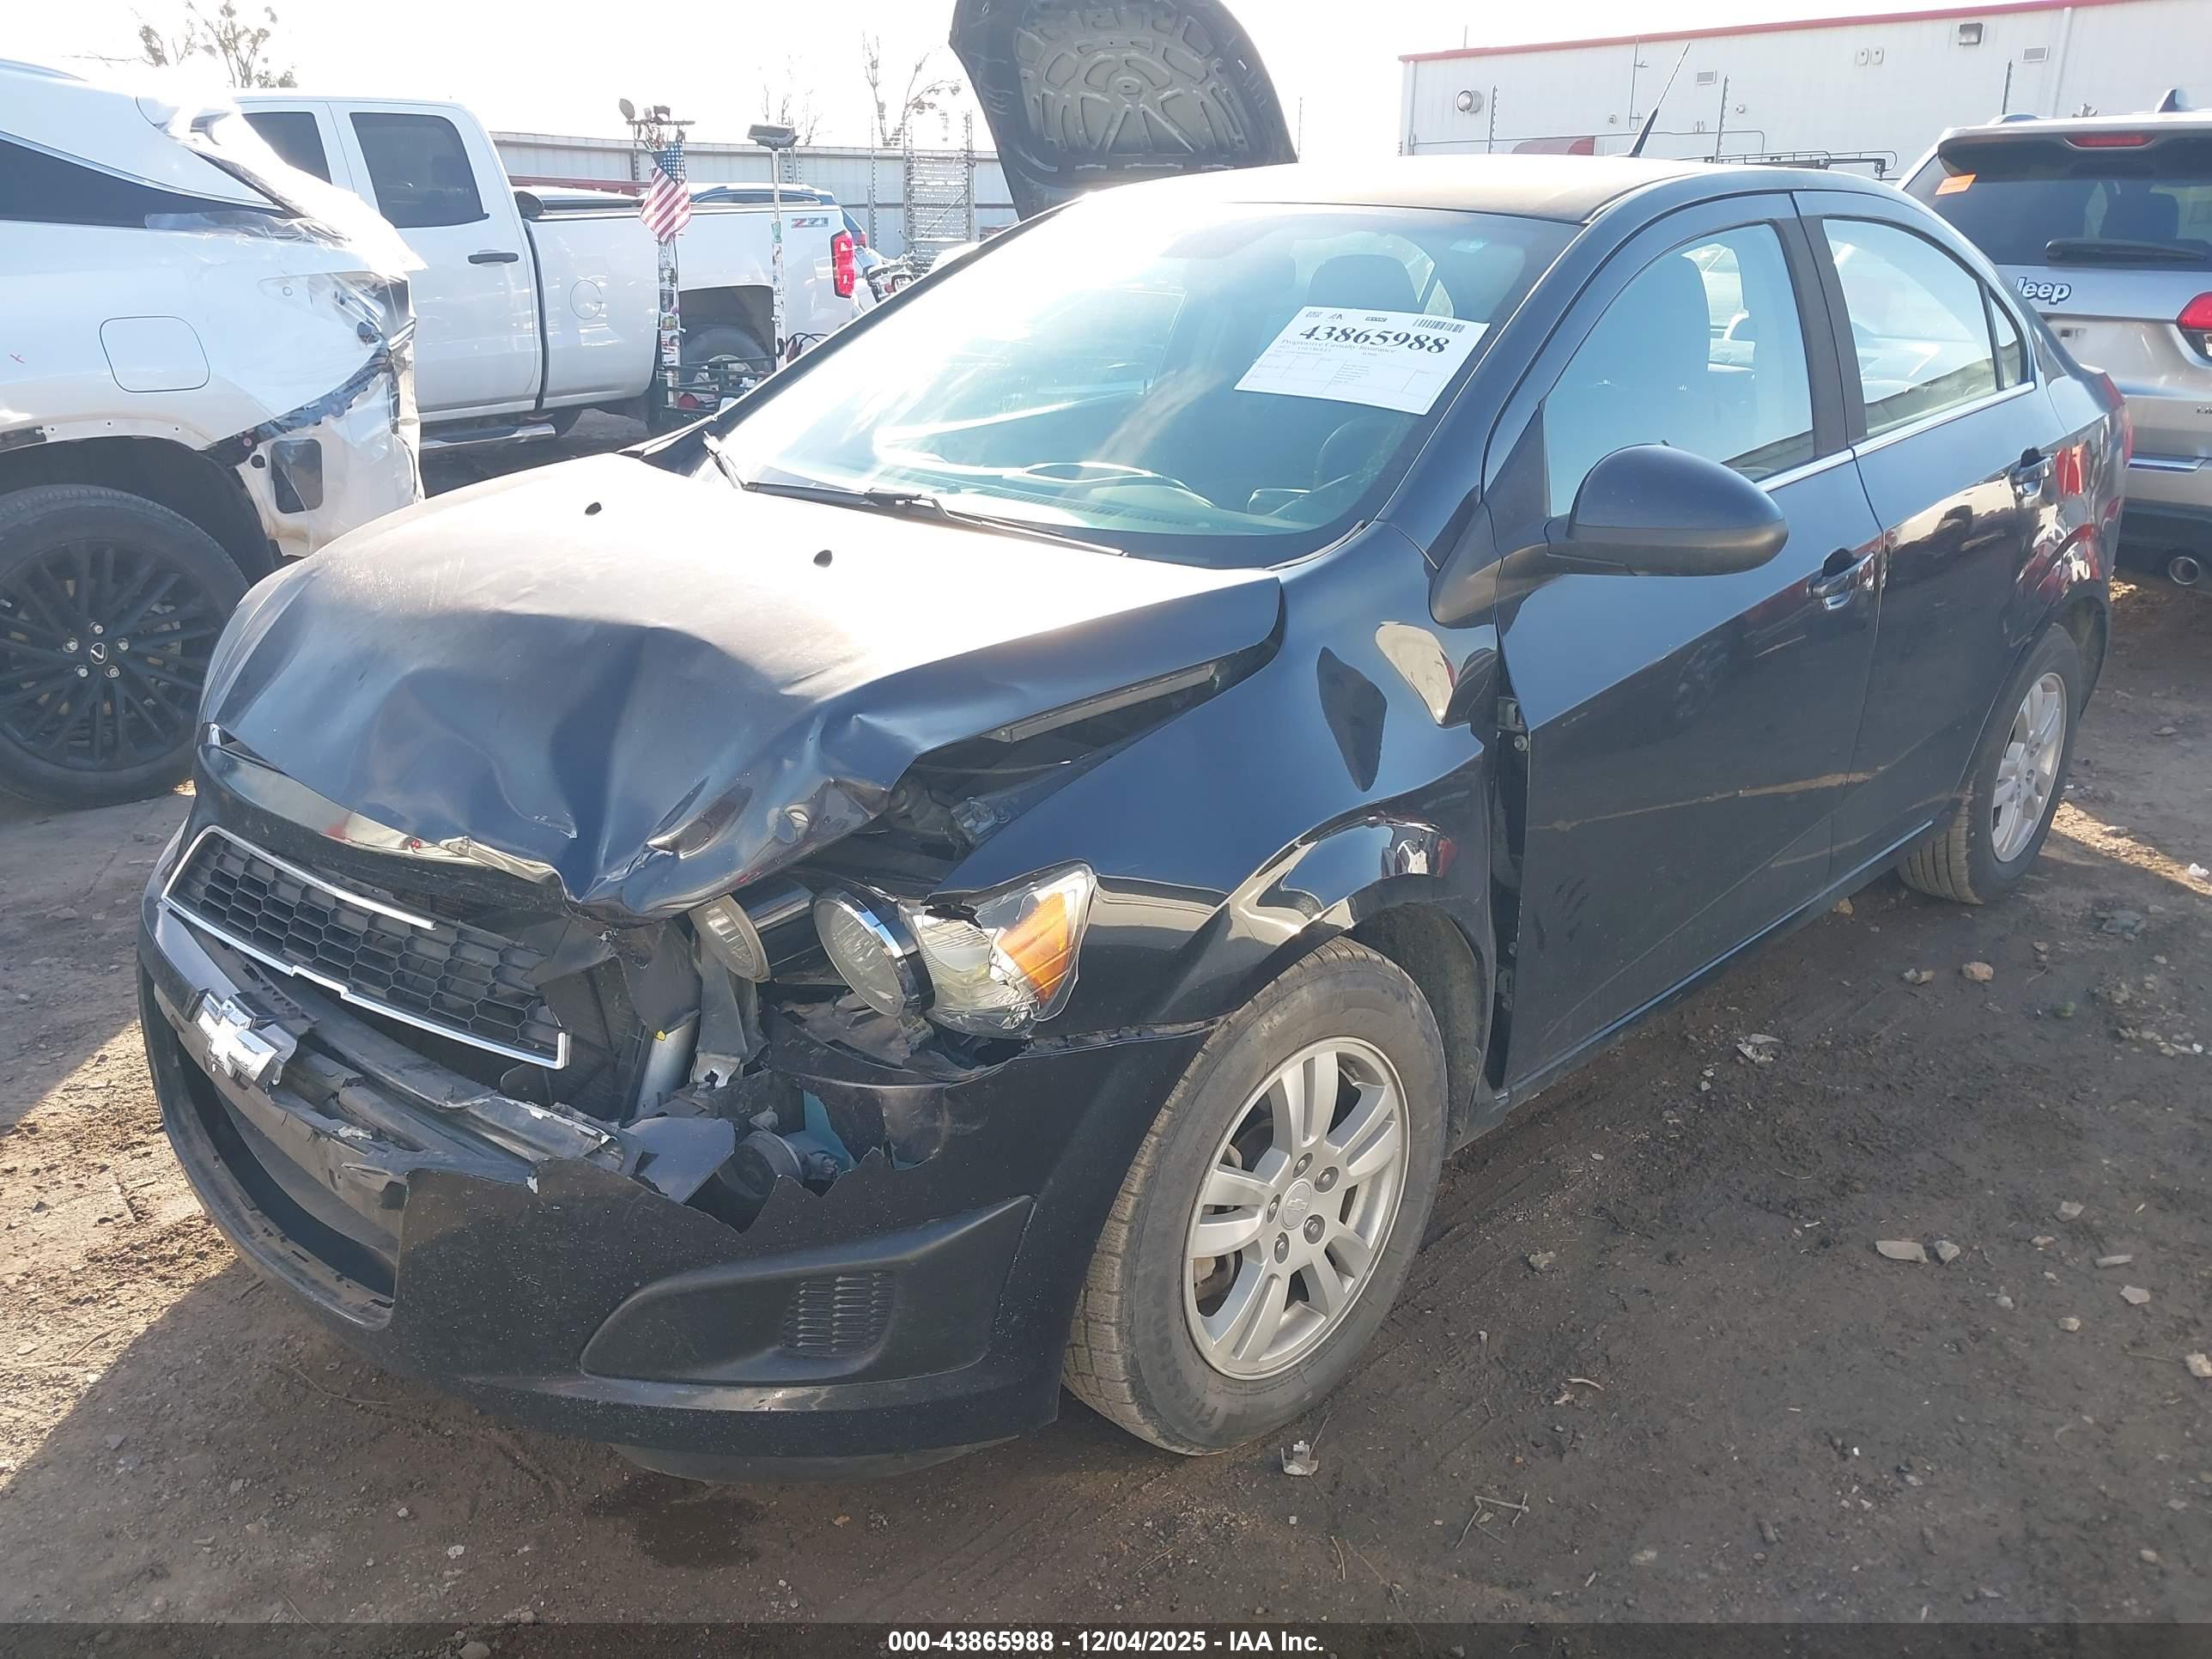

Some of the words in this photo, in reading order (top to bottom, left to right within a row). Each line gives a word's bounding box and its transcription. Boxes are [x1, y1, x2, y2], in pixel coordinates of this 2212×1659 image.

[791, 217, 830, 228] Z71
[2016, 276, 2072, 305] Jeep
[1299, 325, 1450, 355] 43865988
